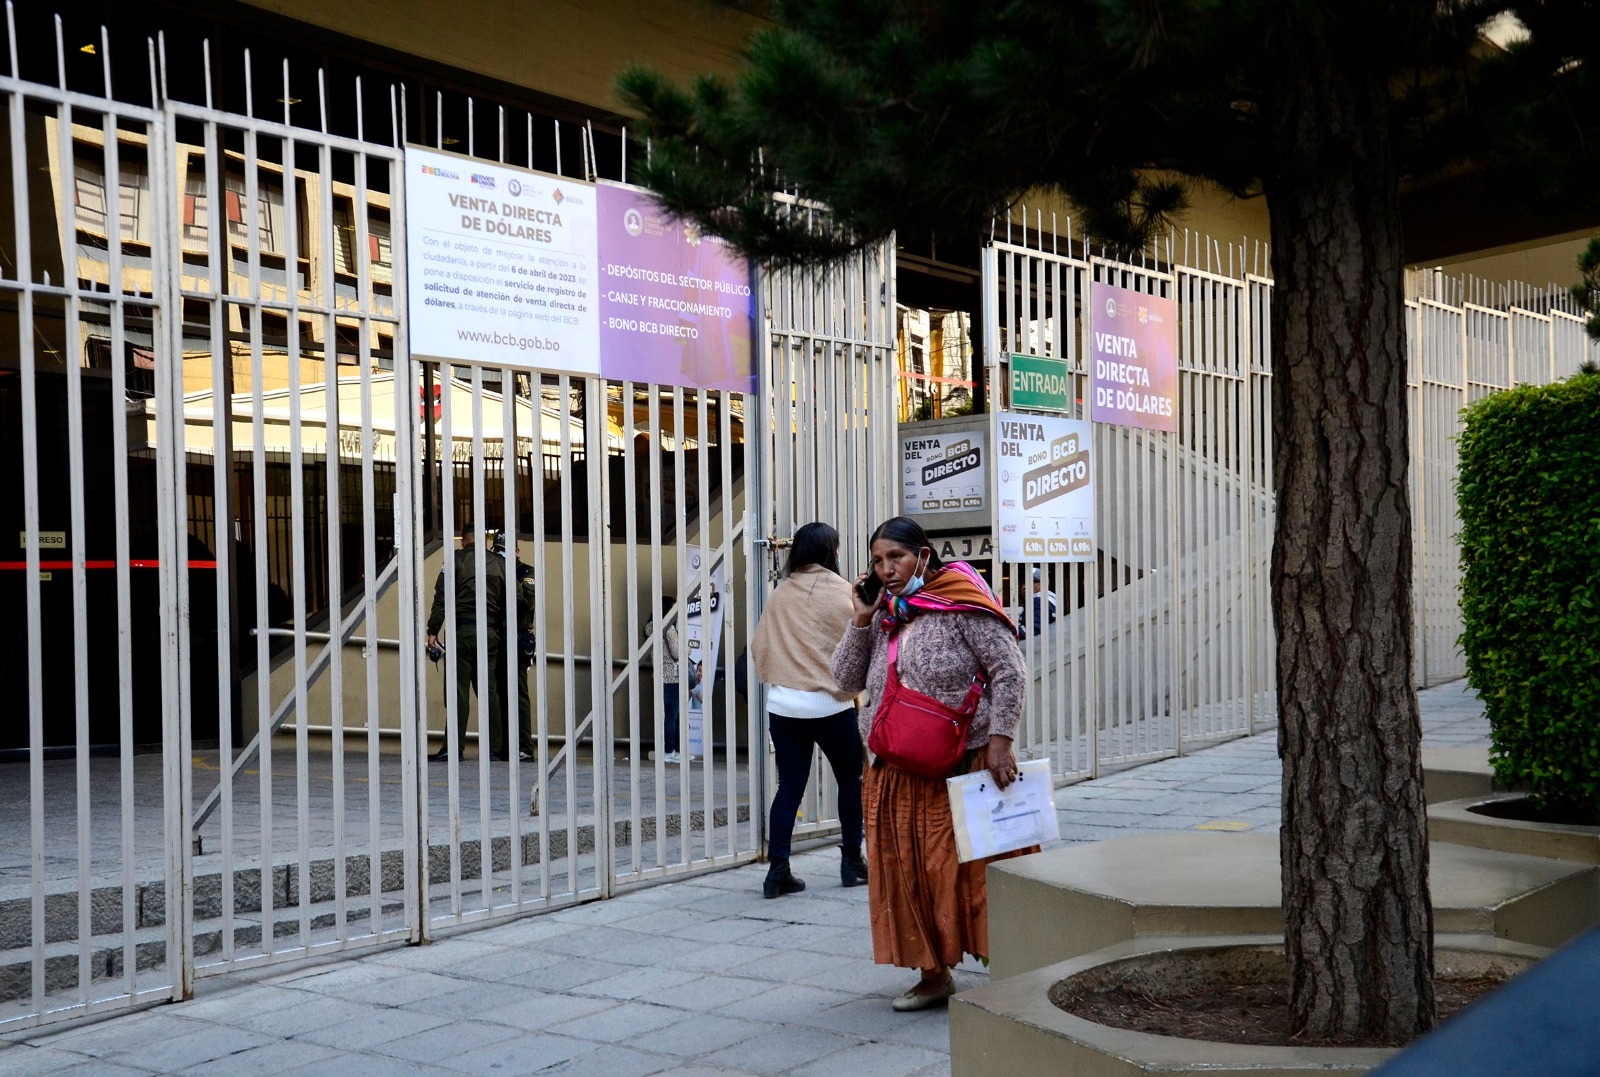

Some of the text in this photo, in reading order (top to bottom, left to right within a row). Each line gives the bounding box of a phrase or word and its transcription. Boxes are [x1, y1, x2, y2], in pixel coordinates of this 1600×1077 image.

[448, 192, 562, 226] VENTA DIRECTA
[461, 214, 552, 244] DE DÓLARES
[423, 236, 438, 246] Con
[443, 240, 450, 248] el
[454, 241, 479, 253] objeto
[482, 246, 492, 255] de
[496, 249, 524, 260] mejorar
[528, 253, 534, 262] la
[538, 256, 568, 268] atención
[580, 262, 586, 270] la
[424, 250, 468, 266] ciudadanía,
[476, 260, 496, 270] partir
[498, 264, 510, 272] del
[518, 266, 528, 275] de
[530, 268, 546, 278] abril
[424, 268, 444, 278] pone
[453, 271, 494, 284] disposición
[505, 280, 534, 290] servicio
[536, 284, 545, 292] de
[548, 286, 576, 297] registro
[578, 290, 586, 298] de
[608, 264, 659, 283] DEPÓSITOS
[660, 272, 677, 286] DEL
[679, 275, 712, 291] SECTOR
[715, 280, 750, 296] PÚBLICO
[424, 282, 586, 312] solicitud de atención de venta directa de
[425, 296, 457, 310] dólares,
[465, 303, 488, 313] través
[489, 306, 498, 314] de
[500, 306, 506, 315] la
[508, 308, 533, 319] página
[535, 313, 549, 321] web
[608, 290, 638, 305] CANJE
[640, 295, 646, 306] Y
[648, 296, 731, 318] FRACCIONAMIENTO
[457, 330, 560, 351] www.bcb.gob.bo
[609, 317, 637, 331] BONO
[640, 320, 657, 334] BCB
[660, 324, 698, 339] DIRECTO
[1096, 332, 1137, 358] VENTA
[1013, 370, 1067, 395] ENTRADA
[1096, 359, 1150, 387] DIRECTA
[1096, 387, 1172, 417] DE DÓLARES
[905, 439, 941, 450] VENTA
[1001, 421, 1045, 442] VENTA
[905, 451, 922, 460] DEL
[927, 443, 968, 462] BONO BCB
[1001, 442, 1023, 457] DEL
[1028, 439, 1076, 465] BONO BCB
[925, 454, 977, 481] DIRECTO
[1026, 460, 1087, 501] DIRECTO
[1031, 520, 1036, 529] 6
[1056, 521, 1059, 530] 1
[1080, 521, 1083, 530] 1
[930, 538, 992, 558] AJA
